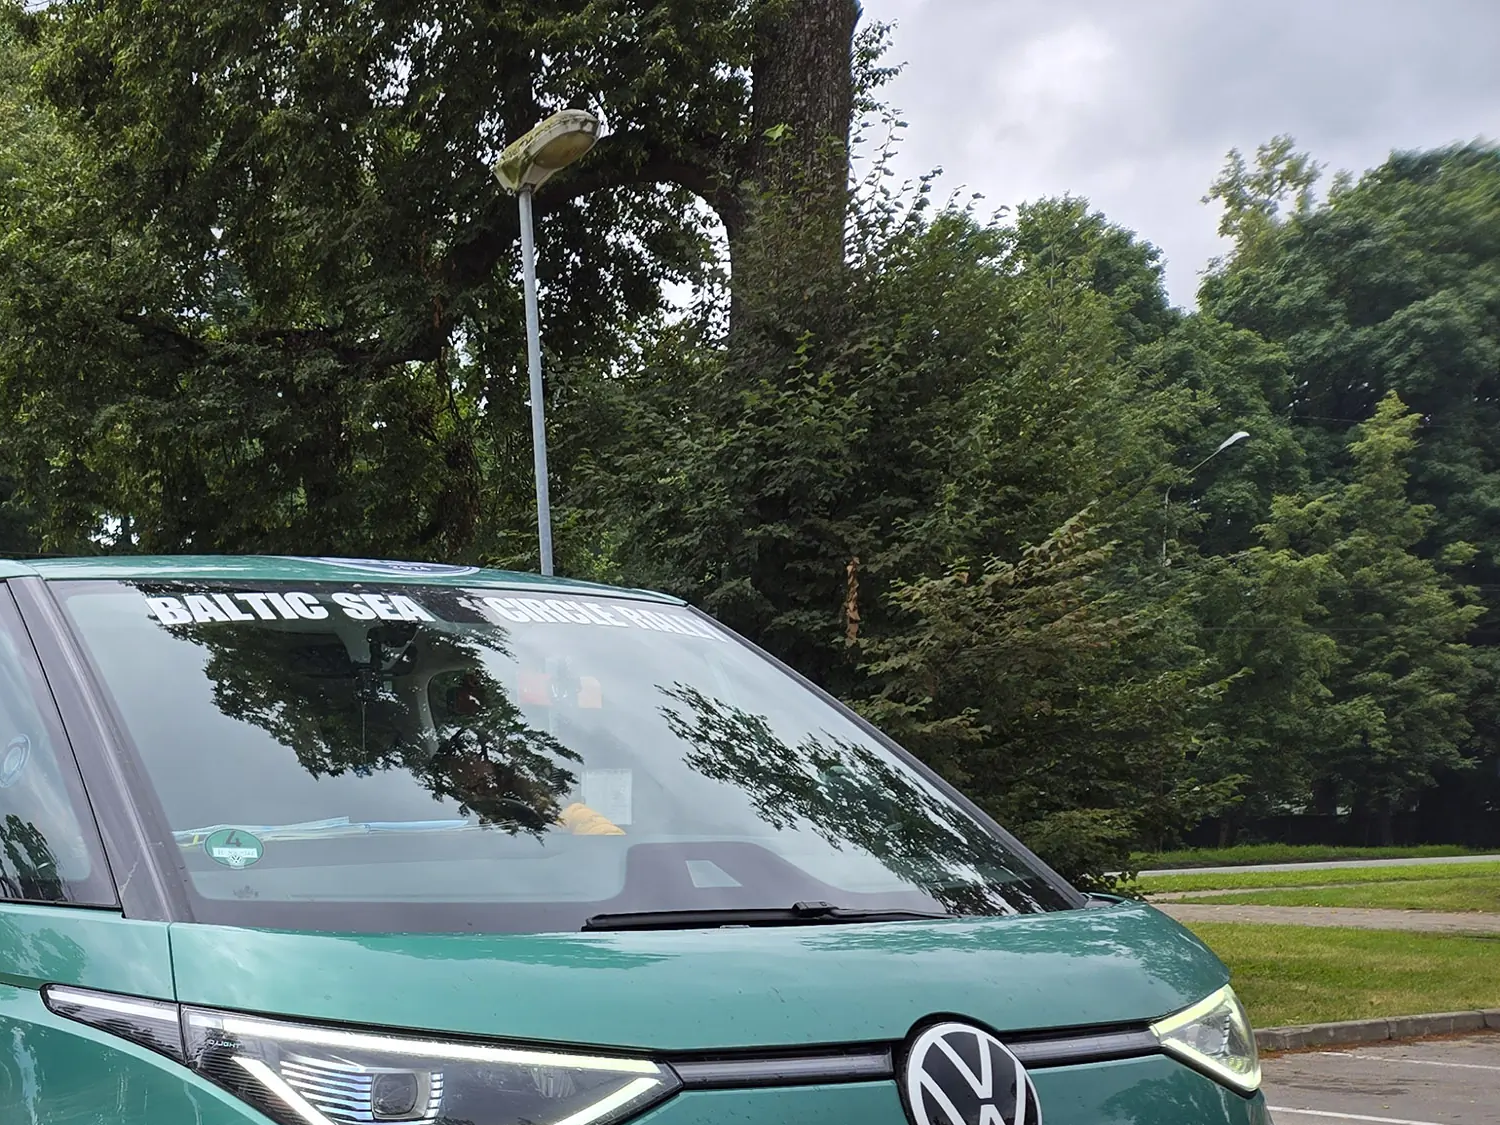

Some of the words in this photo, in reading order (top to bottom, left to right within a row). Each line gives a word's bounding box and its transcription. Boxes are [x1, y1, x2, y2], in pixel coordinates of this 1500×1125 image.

[146, 591, 329, 626] BALTIC
[331, 592, 437, 622] SEA
[483, 596, 629, 628] CIRCLE
[612, 604, 729, 644] RALLY
[225, 829, 243, 848] 4
